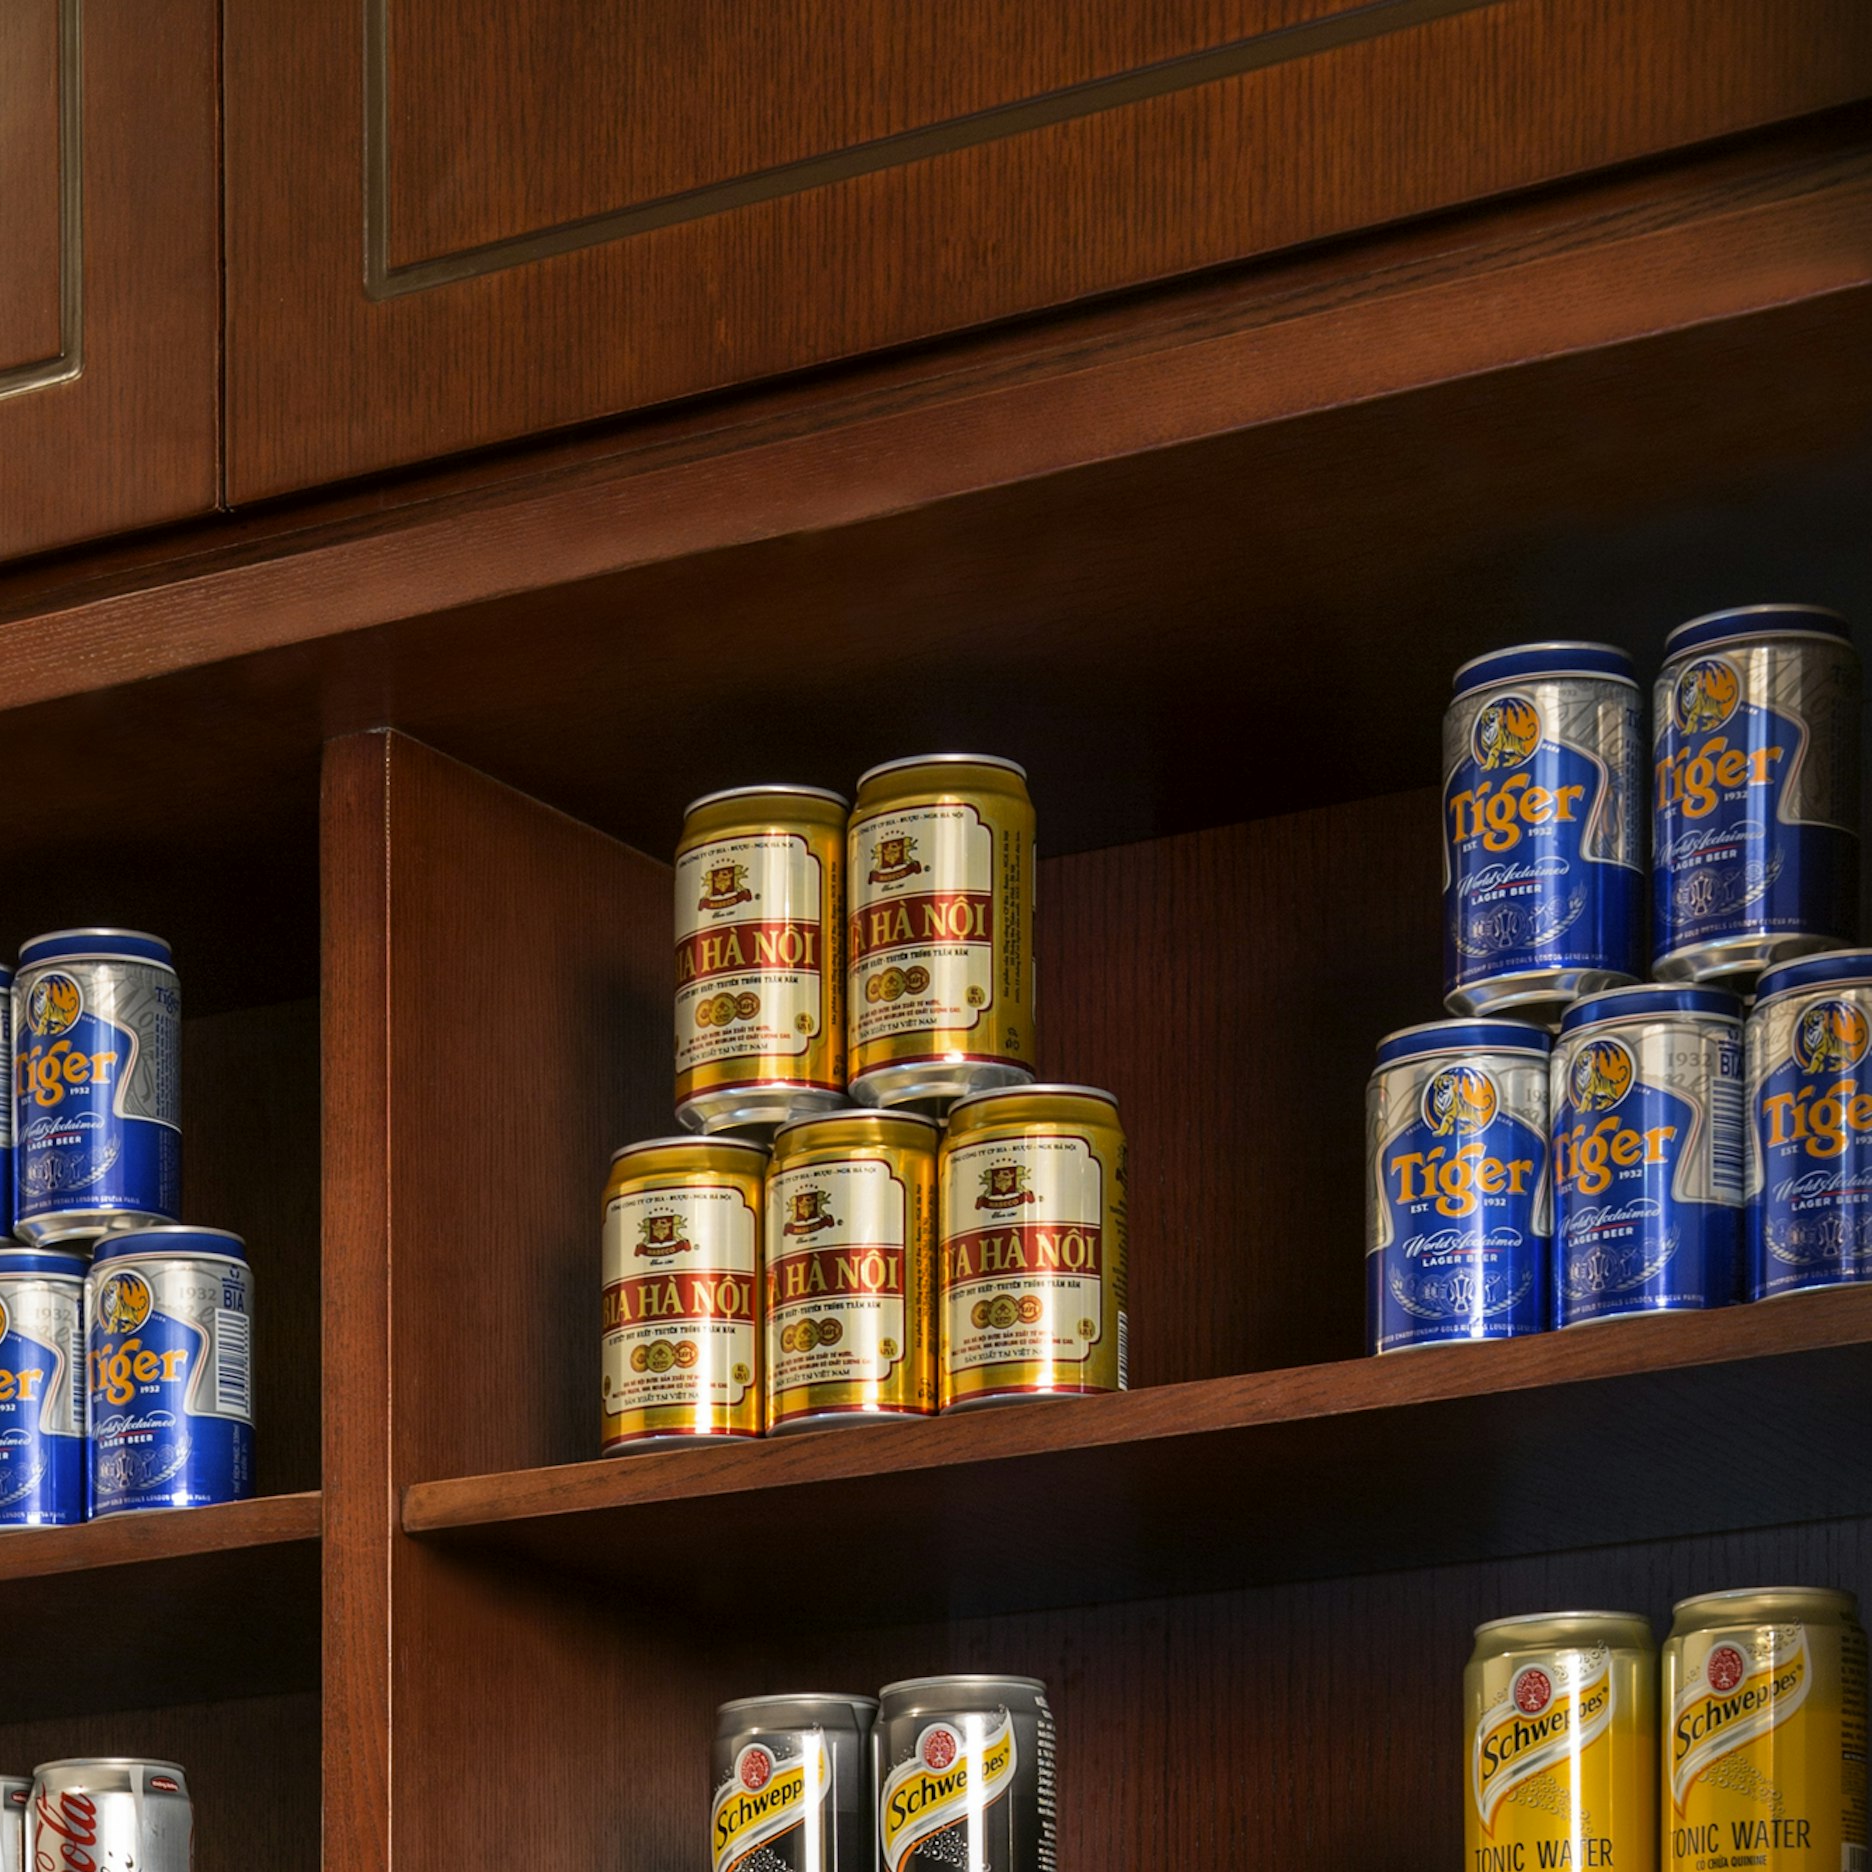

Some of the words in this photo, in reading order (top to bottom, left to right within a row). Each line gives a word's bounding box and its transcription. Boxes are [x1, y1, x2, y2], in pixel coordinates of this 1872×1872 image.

[1449, 774, 1583, 852] Tiger
[1528, 825, 1552, 837] 1932
[1471, 890, 1502, 904] LAGER
[1506, 883, 1543, 898] BEER
[870, 899, 915, 942] HÀ
[923, 894, 987, 938] NỘI
[700, 927, 741, 965] HÀ
[748, 923, 815, 965] NỘI
[12, 1041, 117, 1108] Tiger
[69, 1086, 90, 1096] 1932
[1391, 1144, 1532, 1217] Tiger
[635, 1275, 685, 1316] HÀ
[691, 1270, 752, 1315] NỘI
[1677, 1671, 1797, 1759] Schweppes
